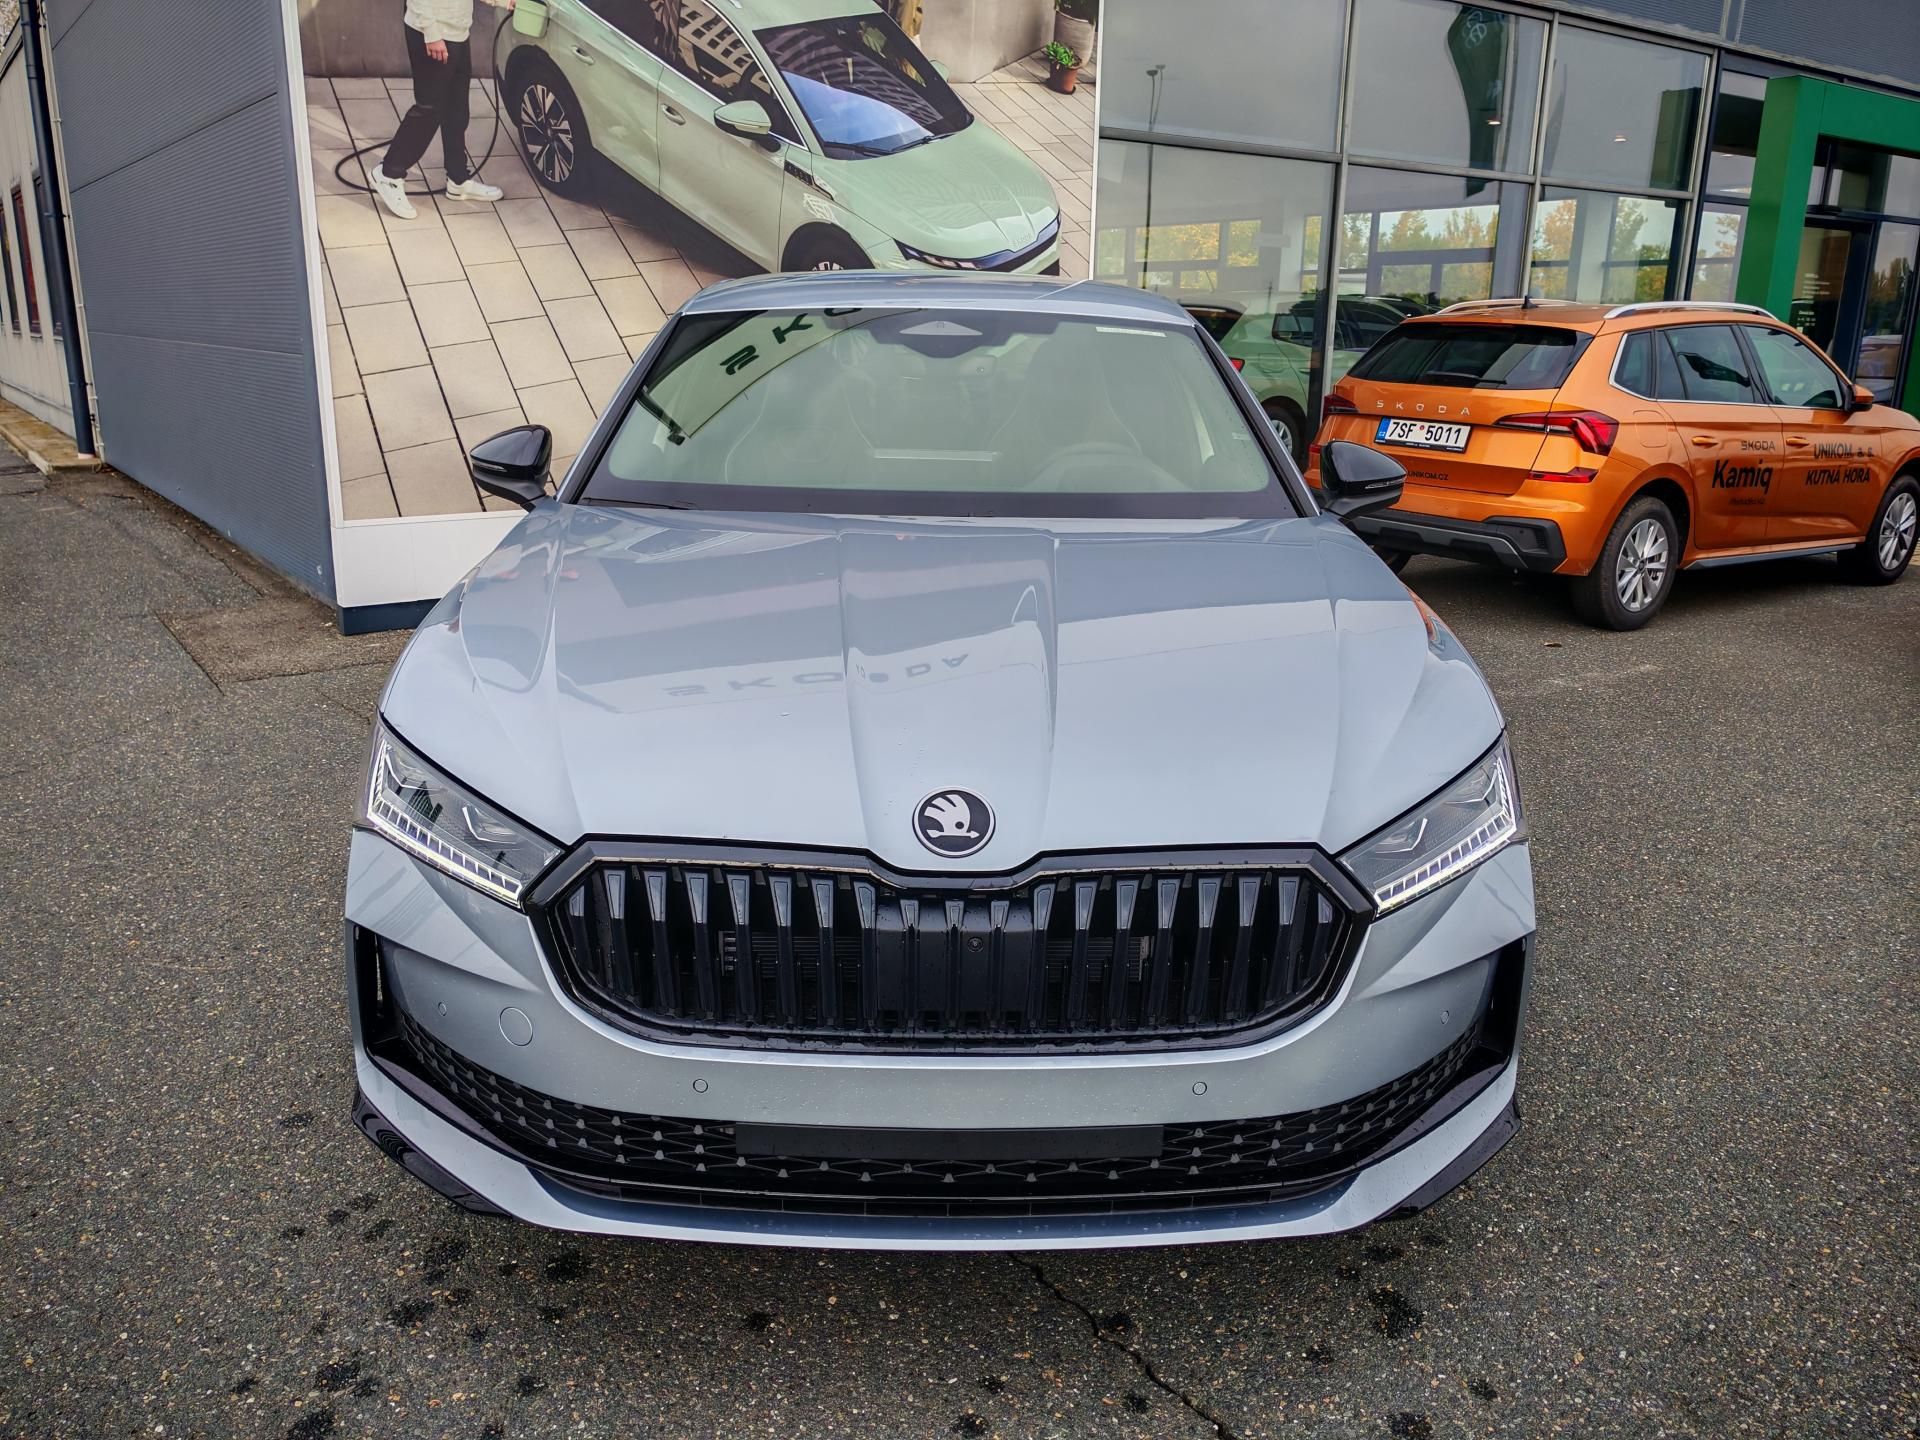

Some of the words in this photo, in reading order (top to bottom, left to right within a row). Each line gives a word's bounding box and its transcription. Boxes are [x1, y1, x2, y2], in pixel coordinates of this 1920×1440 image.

[1389, 421, 1416, 439] 7SF
[1425, 425, 1461, 445] 5011
[1711, 459, 1774, 495] Kamiq
[1843, 467, 1870, 483] HORA
